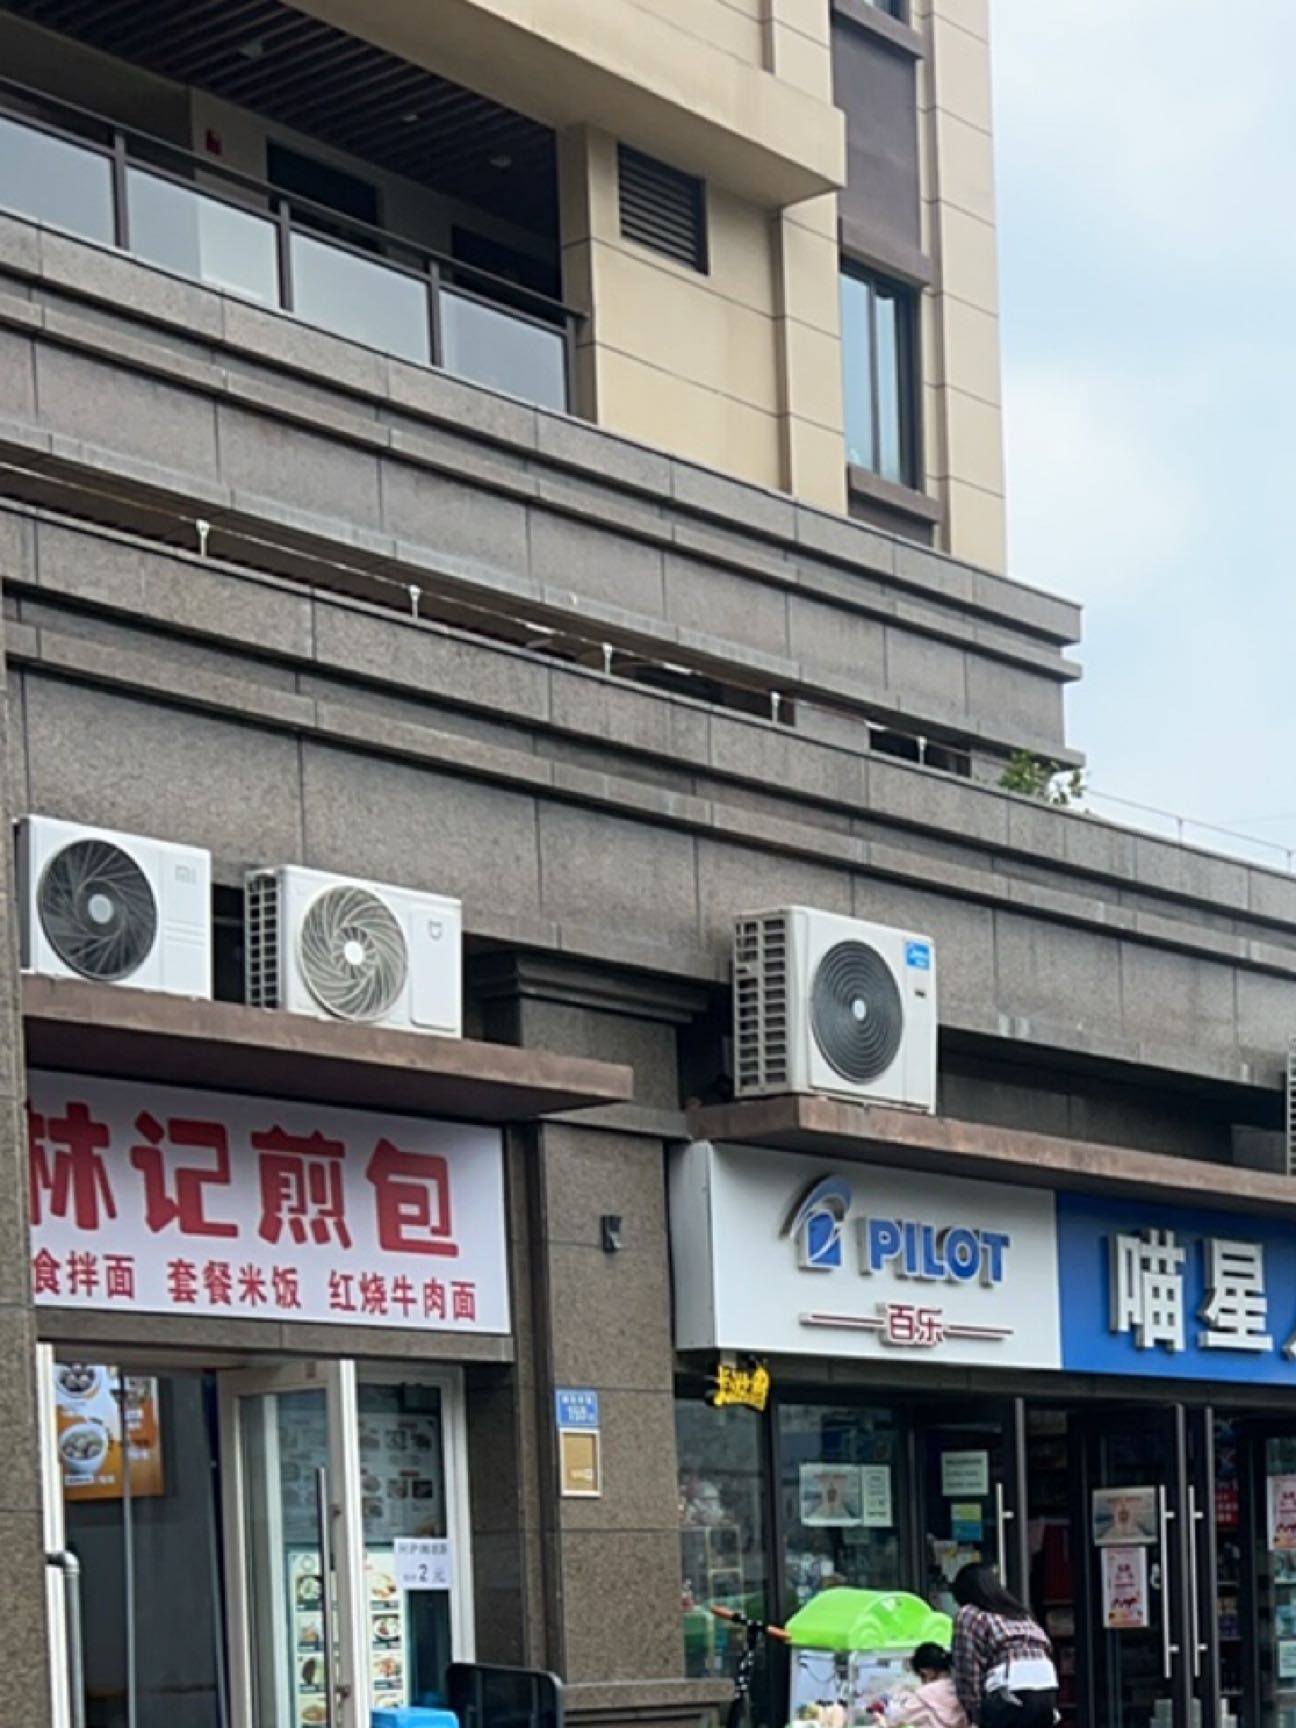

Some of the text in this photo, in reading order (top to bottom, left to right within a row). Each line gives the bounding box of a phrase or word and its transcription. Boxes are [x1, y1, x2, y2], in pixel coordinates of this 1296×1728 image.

[28, 1101, 459, 1258] 林记煎包
[34, 1247, 477, 1322] 食拌面 套餐米饭 红烧牛肉面
[867, 1217, 1011, 1284] PILOT
[885, 1302, 945, 1343] 百乐
